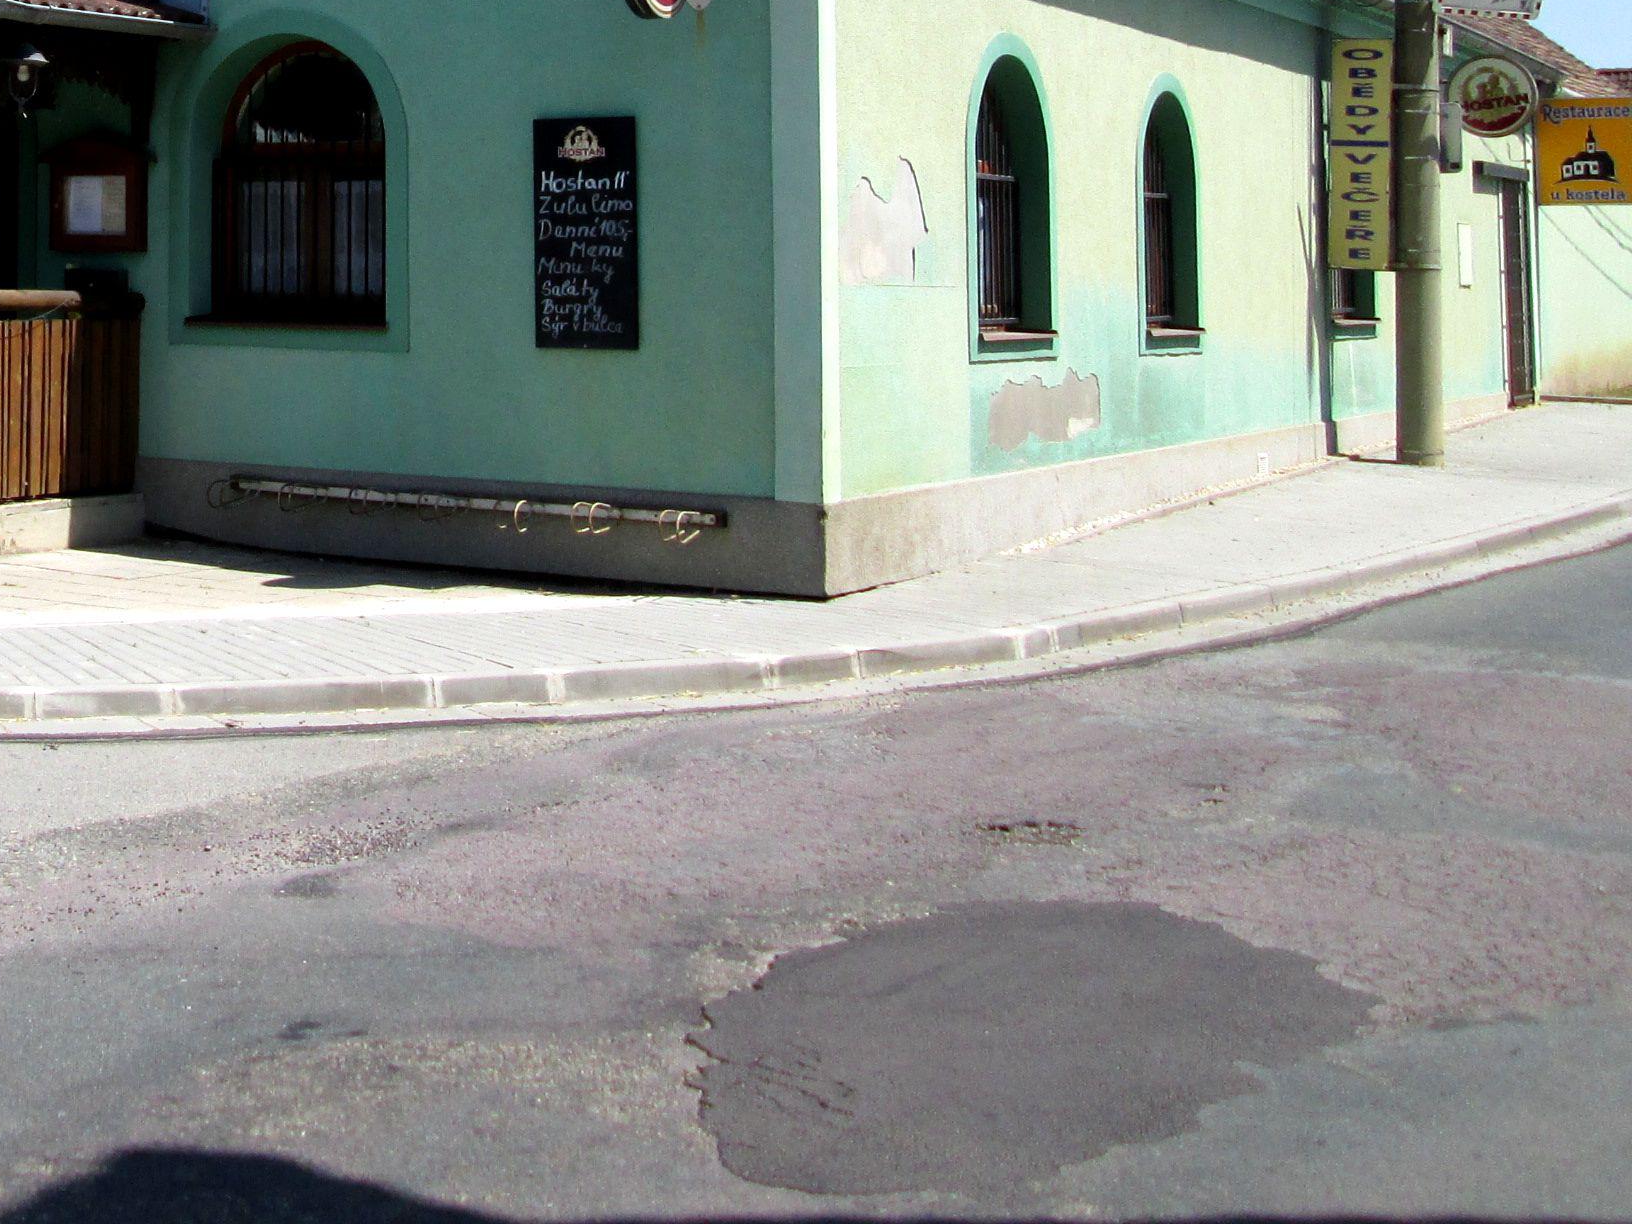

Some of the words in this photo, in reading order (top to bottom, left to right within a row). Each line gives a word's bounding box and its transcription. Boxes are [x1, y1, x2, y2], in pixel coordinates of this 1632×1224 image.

[1341, 48, 1383, 136] OBĚDY
[1542, 104, 1630, 124] Restaurace
[557, 147, 606, 158] HOSTAN
[541, 169, 610, 193] Hostan
[1550, 192, 1560, 200] u
[1566, 187, 1626, 201] kostela
